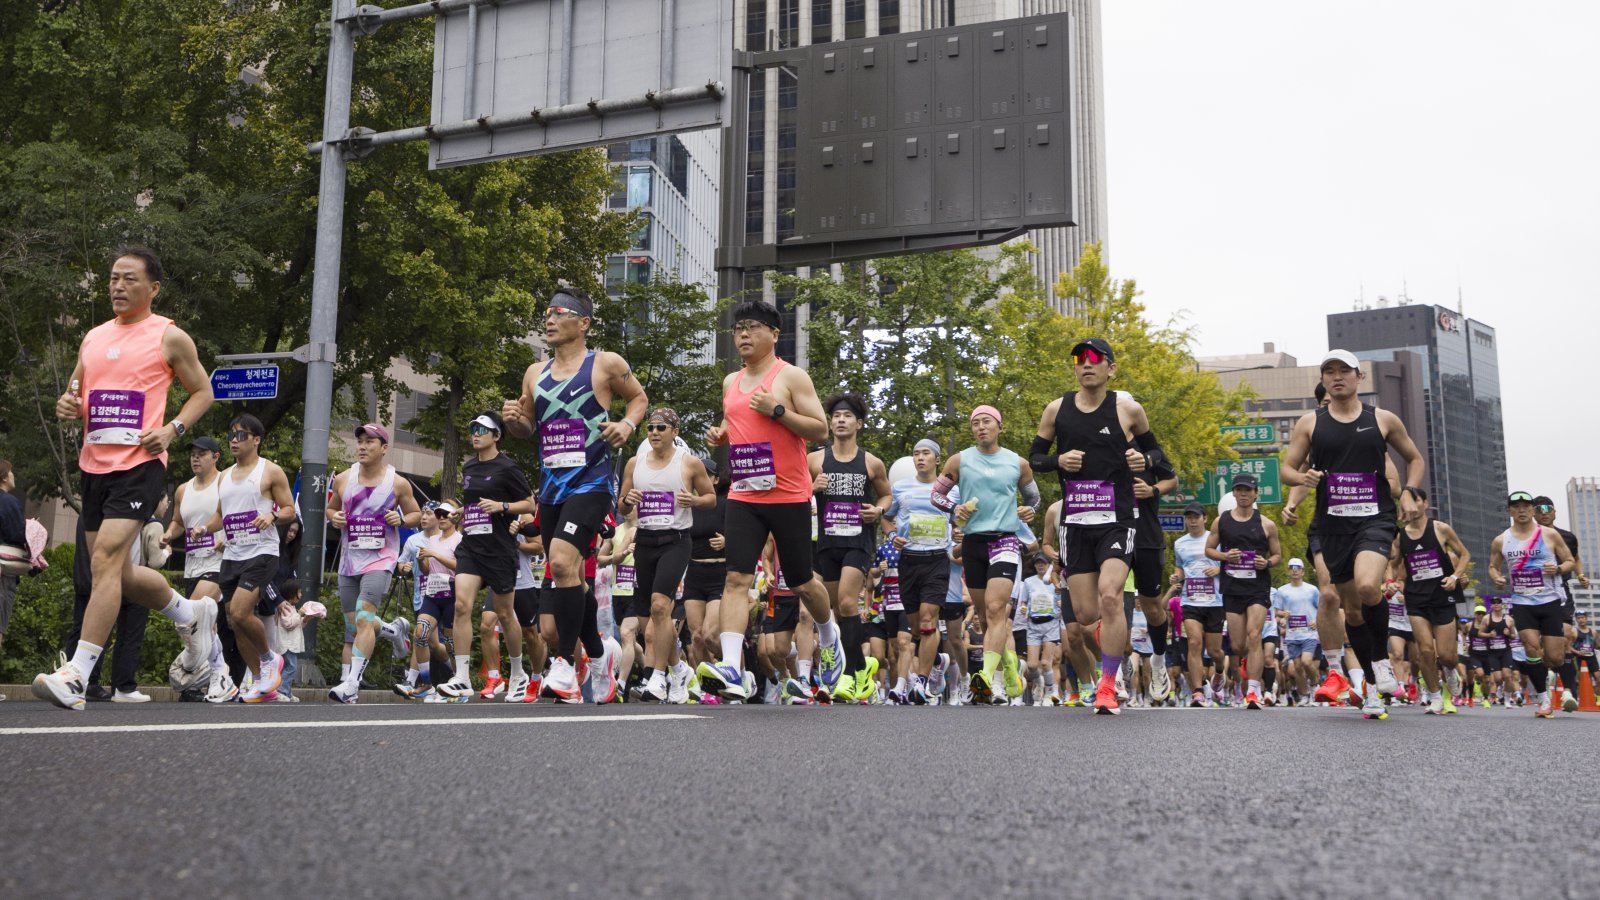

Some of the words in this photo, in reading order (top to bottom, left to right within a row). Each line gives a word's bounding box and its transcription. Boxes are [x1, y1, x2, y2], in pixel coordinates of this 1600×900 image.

[246, 369, 275, 380] 청계천로
[217, 381, 275, 390] Cheonggyecheon-ro
[97, 406, 120, 416] 김진태
[1229, 461, 1266, 473] 숭례문
[1507, 550, 1526, 558] RUN
